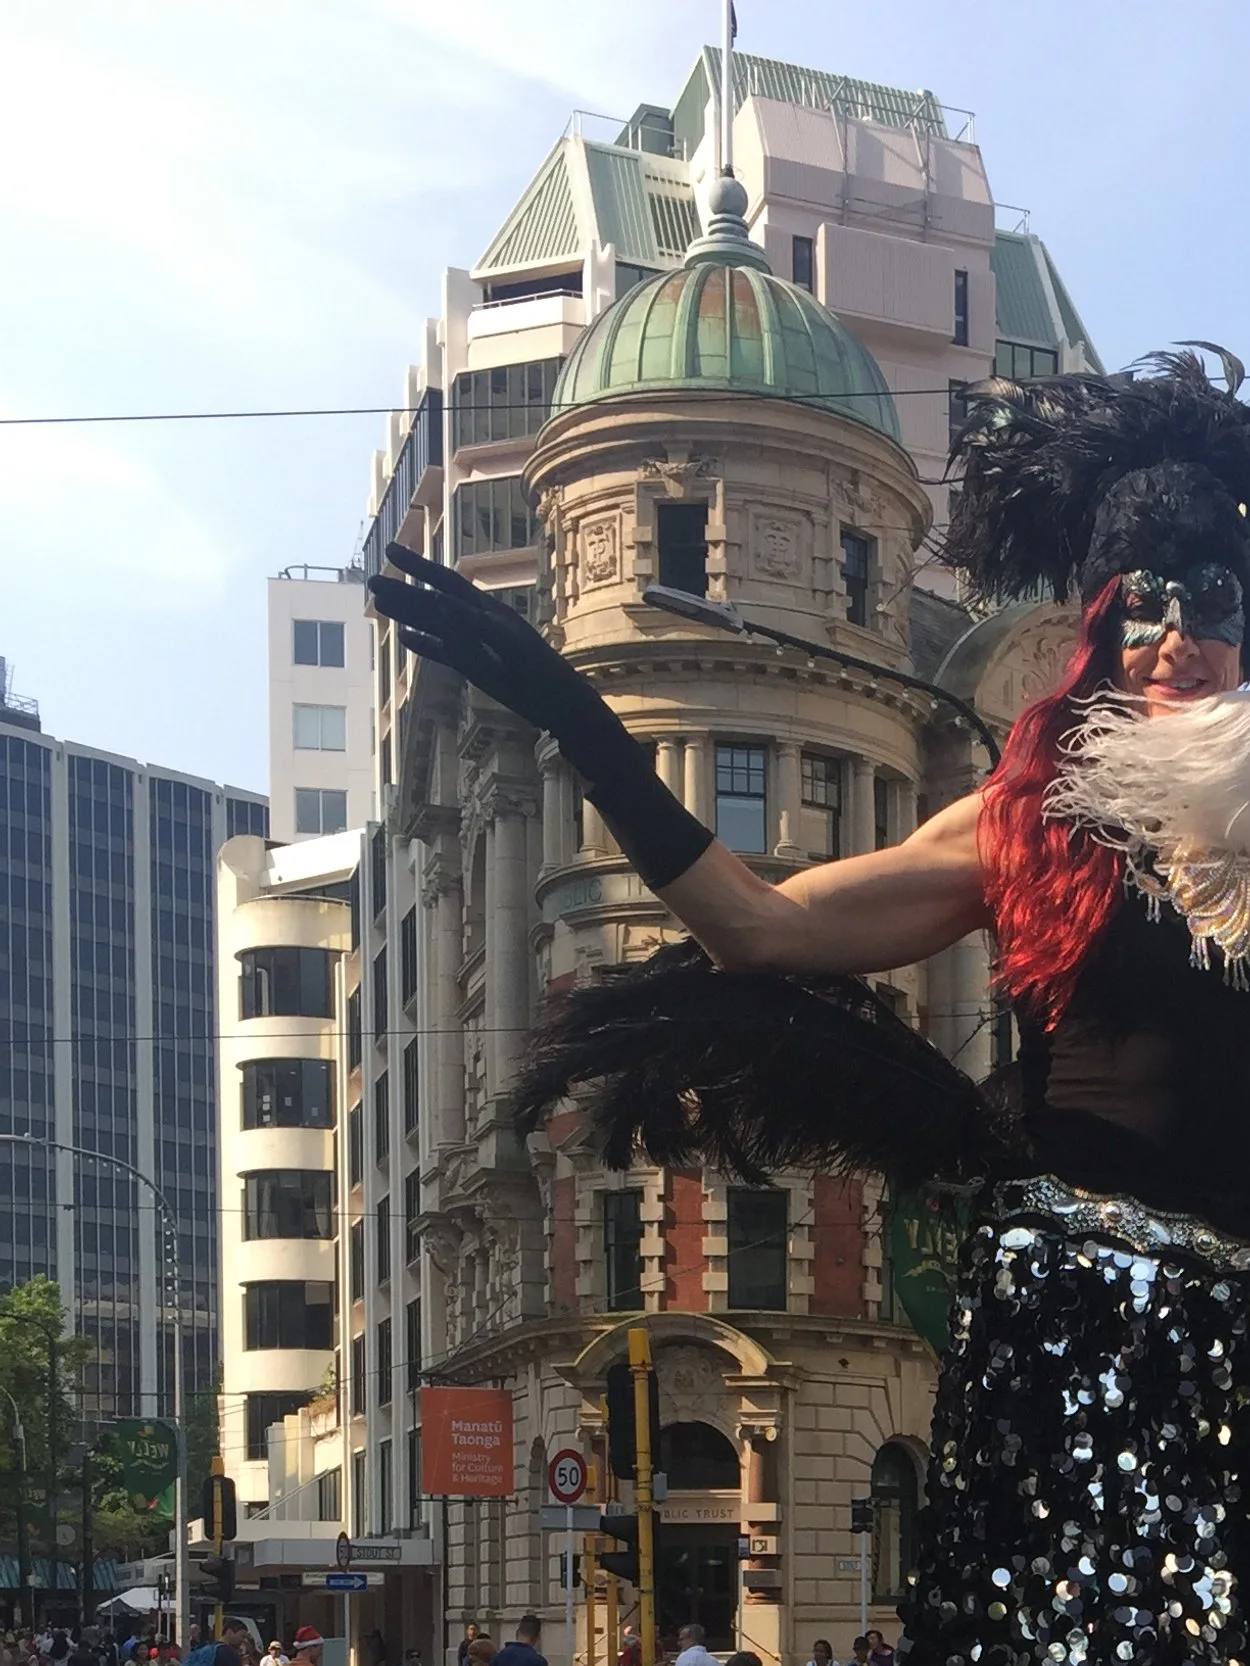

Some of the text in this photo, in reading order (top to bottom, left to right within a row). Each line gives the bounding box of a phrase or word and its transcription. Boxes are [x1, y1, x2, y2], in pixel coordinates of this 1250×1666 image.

[451, 1420, 503, 1433] Manatū
[451, 1433, 501, 1449] Taonga
[452, 1452, 491, 1465] Ministry
[452, 1461, 504, 1473] for Culture
[461, 1474, 503, 1486] Heritage
[558, 1467, 579, 1487] 50
[662, 1509, 735, 1519] BLIC TRUST
